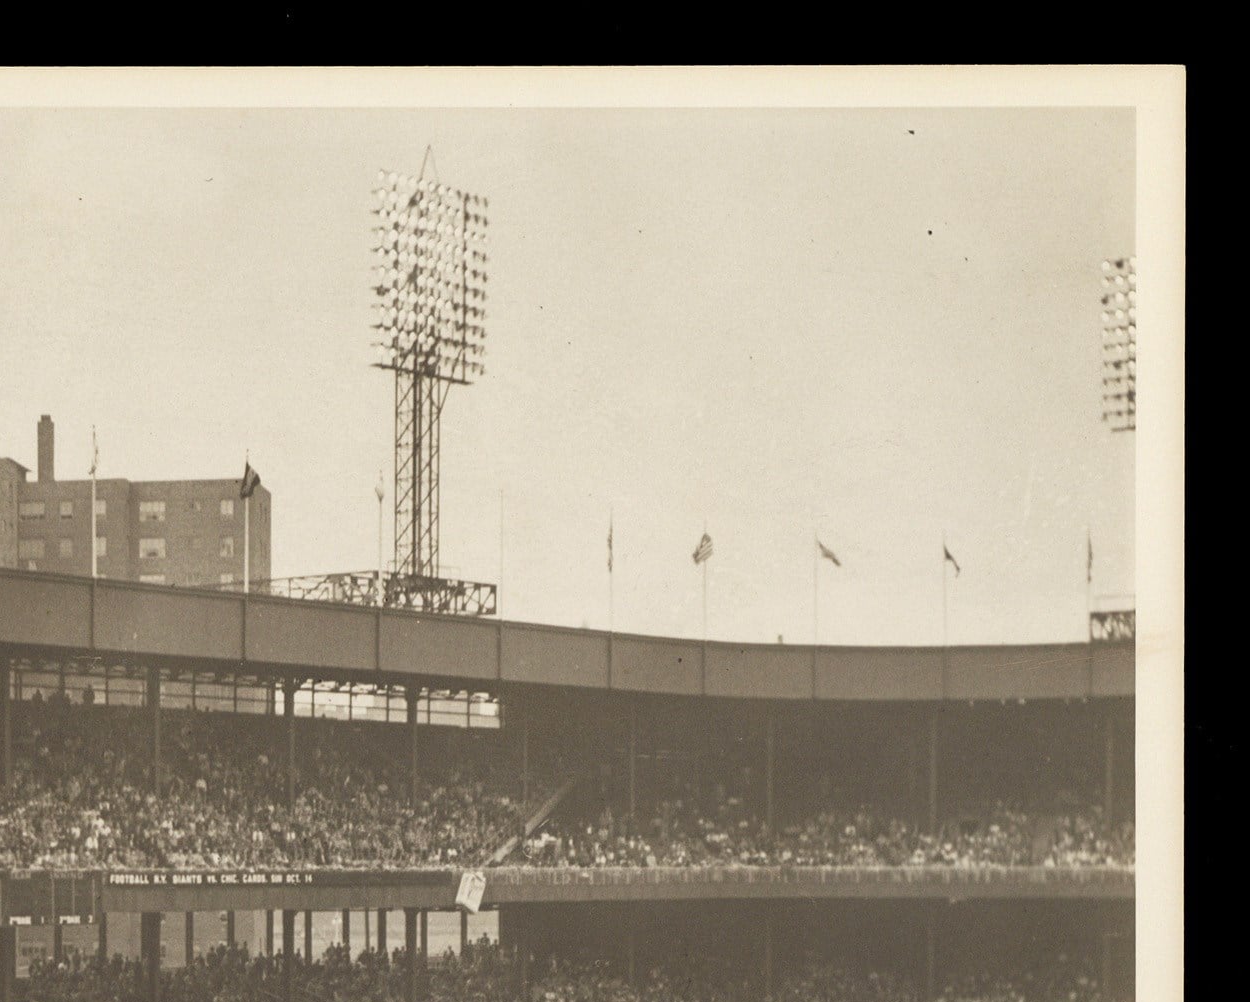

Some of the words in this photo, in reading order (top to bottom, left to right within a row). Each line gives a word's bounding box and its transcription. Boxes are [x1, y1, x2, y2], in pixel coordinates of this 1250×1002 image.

[109, 874, 150, 885] FOOTBALL
[172, 874, 203, 885] GIANTS
[221, 873, 240, 884] CHIC.
[243, 873, 269, 884] CARDS.
